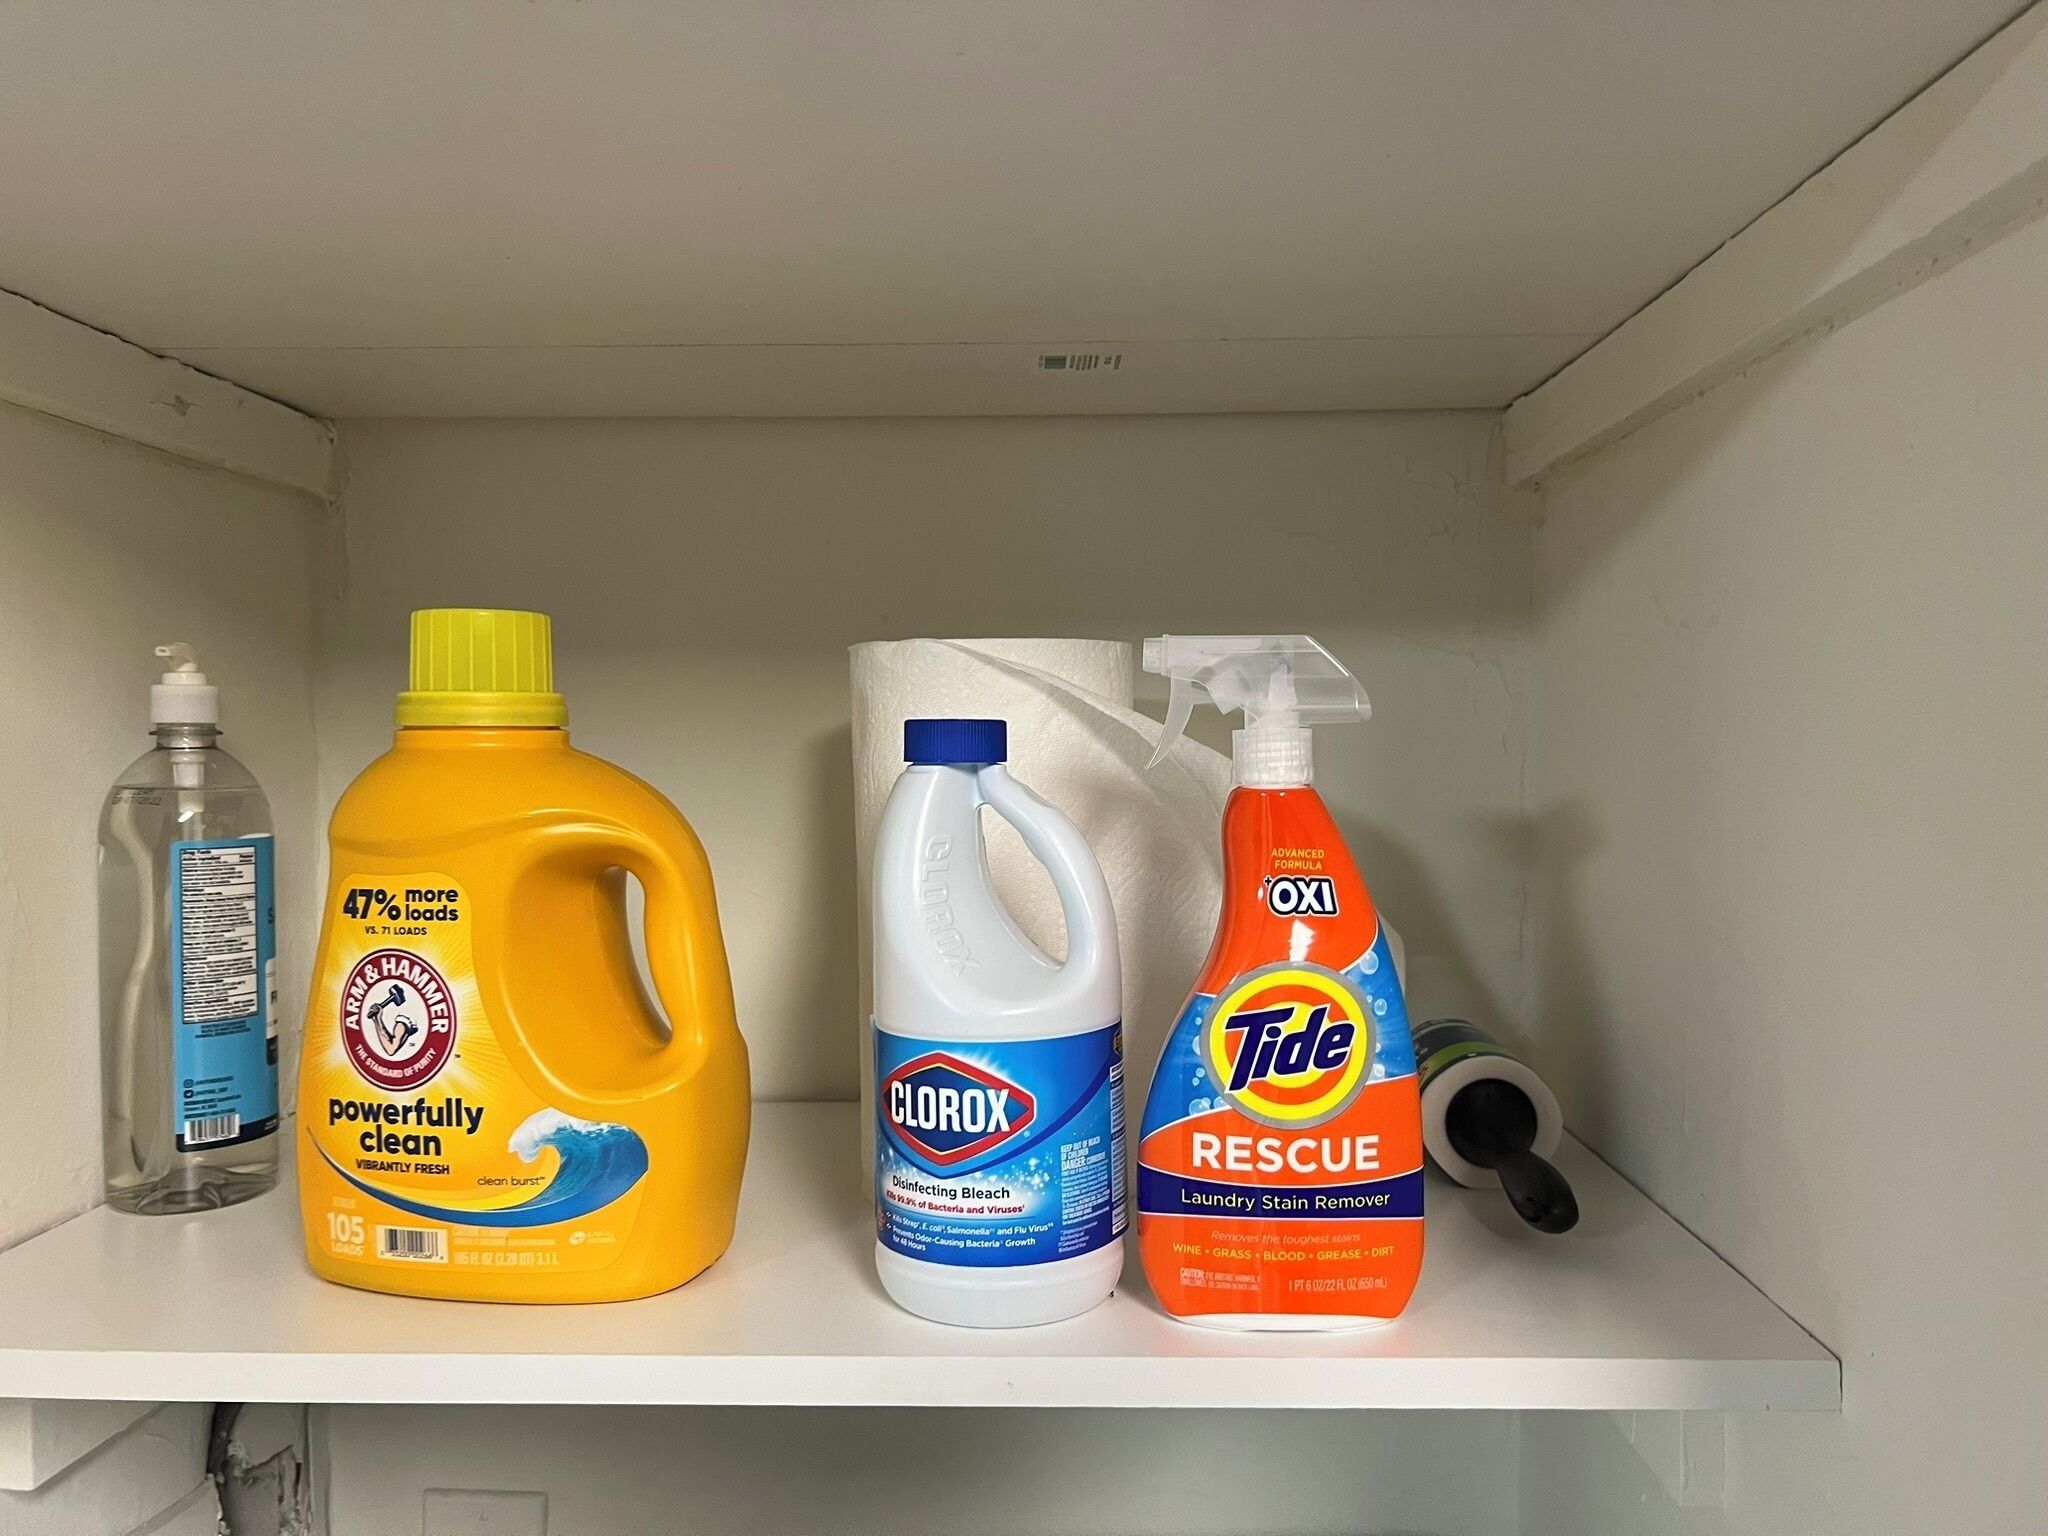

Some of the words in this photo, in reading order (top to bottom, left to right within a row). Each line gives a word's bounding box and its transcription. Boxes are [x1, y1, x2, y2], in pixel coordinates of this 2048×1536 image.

[1271, 848, 1325, 859] ADVANCED
[1274, 860, 1322, 870] FORMULA
[343, 888, 401, 921] 47%
[405, 888, 459, 903] more
[405, 904, 459, 921] loads
[365, 926, 379, 935] VS.
[381, 926, 391, 935] 71
[393, 926, 428, 936] LOADS
[345, 979, 368, 1031] ARM
[364, 963, 382, 983] &
[381, 957, 449, 1034] HAMMER
[1225, 1005, 1356, 1092] Tide
[355, 1044, 369, 1061] THE
[365, 1058, 403, 1078] STANDARD
[414, 1048, 437, 1073] PURITY
[891, 1080, 1011, 1134] CLOROX
[329, 1098, 484, 1135] powerfully
[360, 1124, 442, 1156] clean
[1192, 1132, 1380, 1174] RESCUE
[356, 1159, 412, 1173] VIBRANTLY
[414, 1163, 450, 1175] FRESH
[477, 1176, 508, 1186] clean
[893, 1175, 957, 1200] Disinfecting
[961, 1187, 1010, 1199] Bleach
[918, 1201, 926, 1209] of
[928, 1202, 964, 1214] Bacteria
[966, 1205, 984, 1214] and
[1181, 1189, 1255, 1212] Laundry
[1262, 1195, 1308, 1210] Stain
[1315, 1194, 1390, 1210] Remover
[327, 1212, 366, 1244] 105
[997, 1227, 1012, 1235] and
[1014, 1226, 1026, 1234] Flu
[908, 1240, 926, 1251] Hours
[915, 1233, 964, 1248] Odor-Causing
[1005, 1238, 1036, 1247] Growth
[1211, 1230, 1259, 1243] Removes
[1262, 1233, 1280, 1244] the
[1283, 1234, 1329, 1245] toughest
[1332, 1233, 1360, 1243] stains
[1173, 1243, 1202, 1255] WINE
[1213, 1248, 1252, 1259] GRASS
[1263, 1251, 1305, 1261] BLOOD
[1317, 1249, 1361, 1261] GREASE
[1371, 1246, 1394, 1257] DIRT
